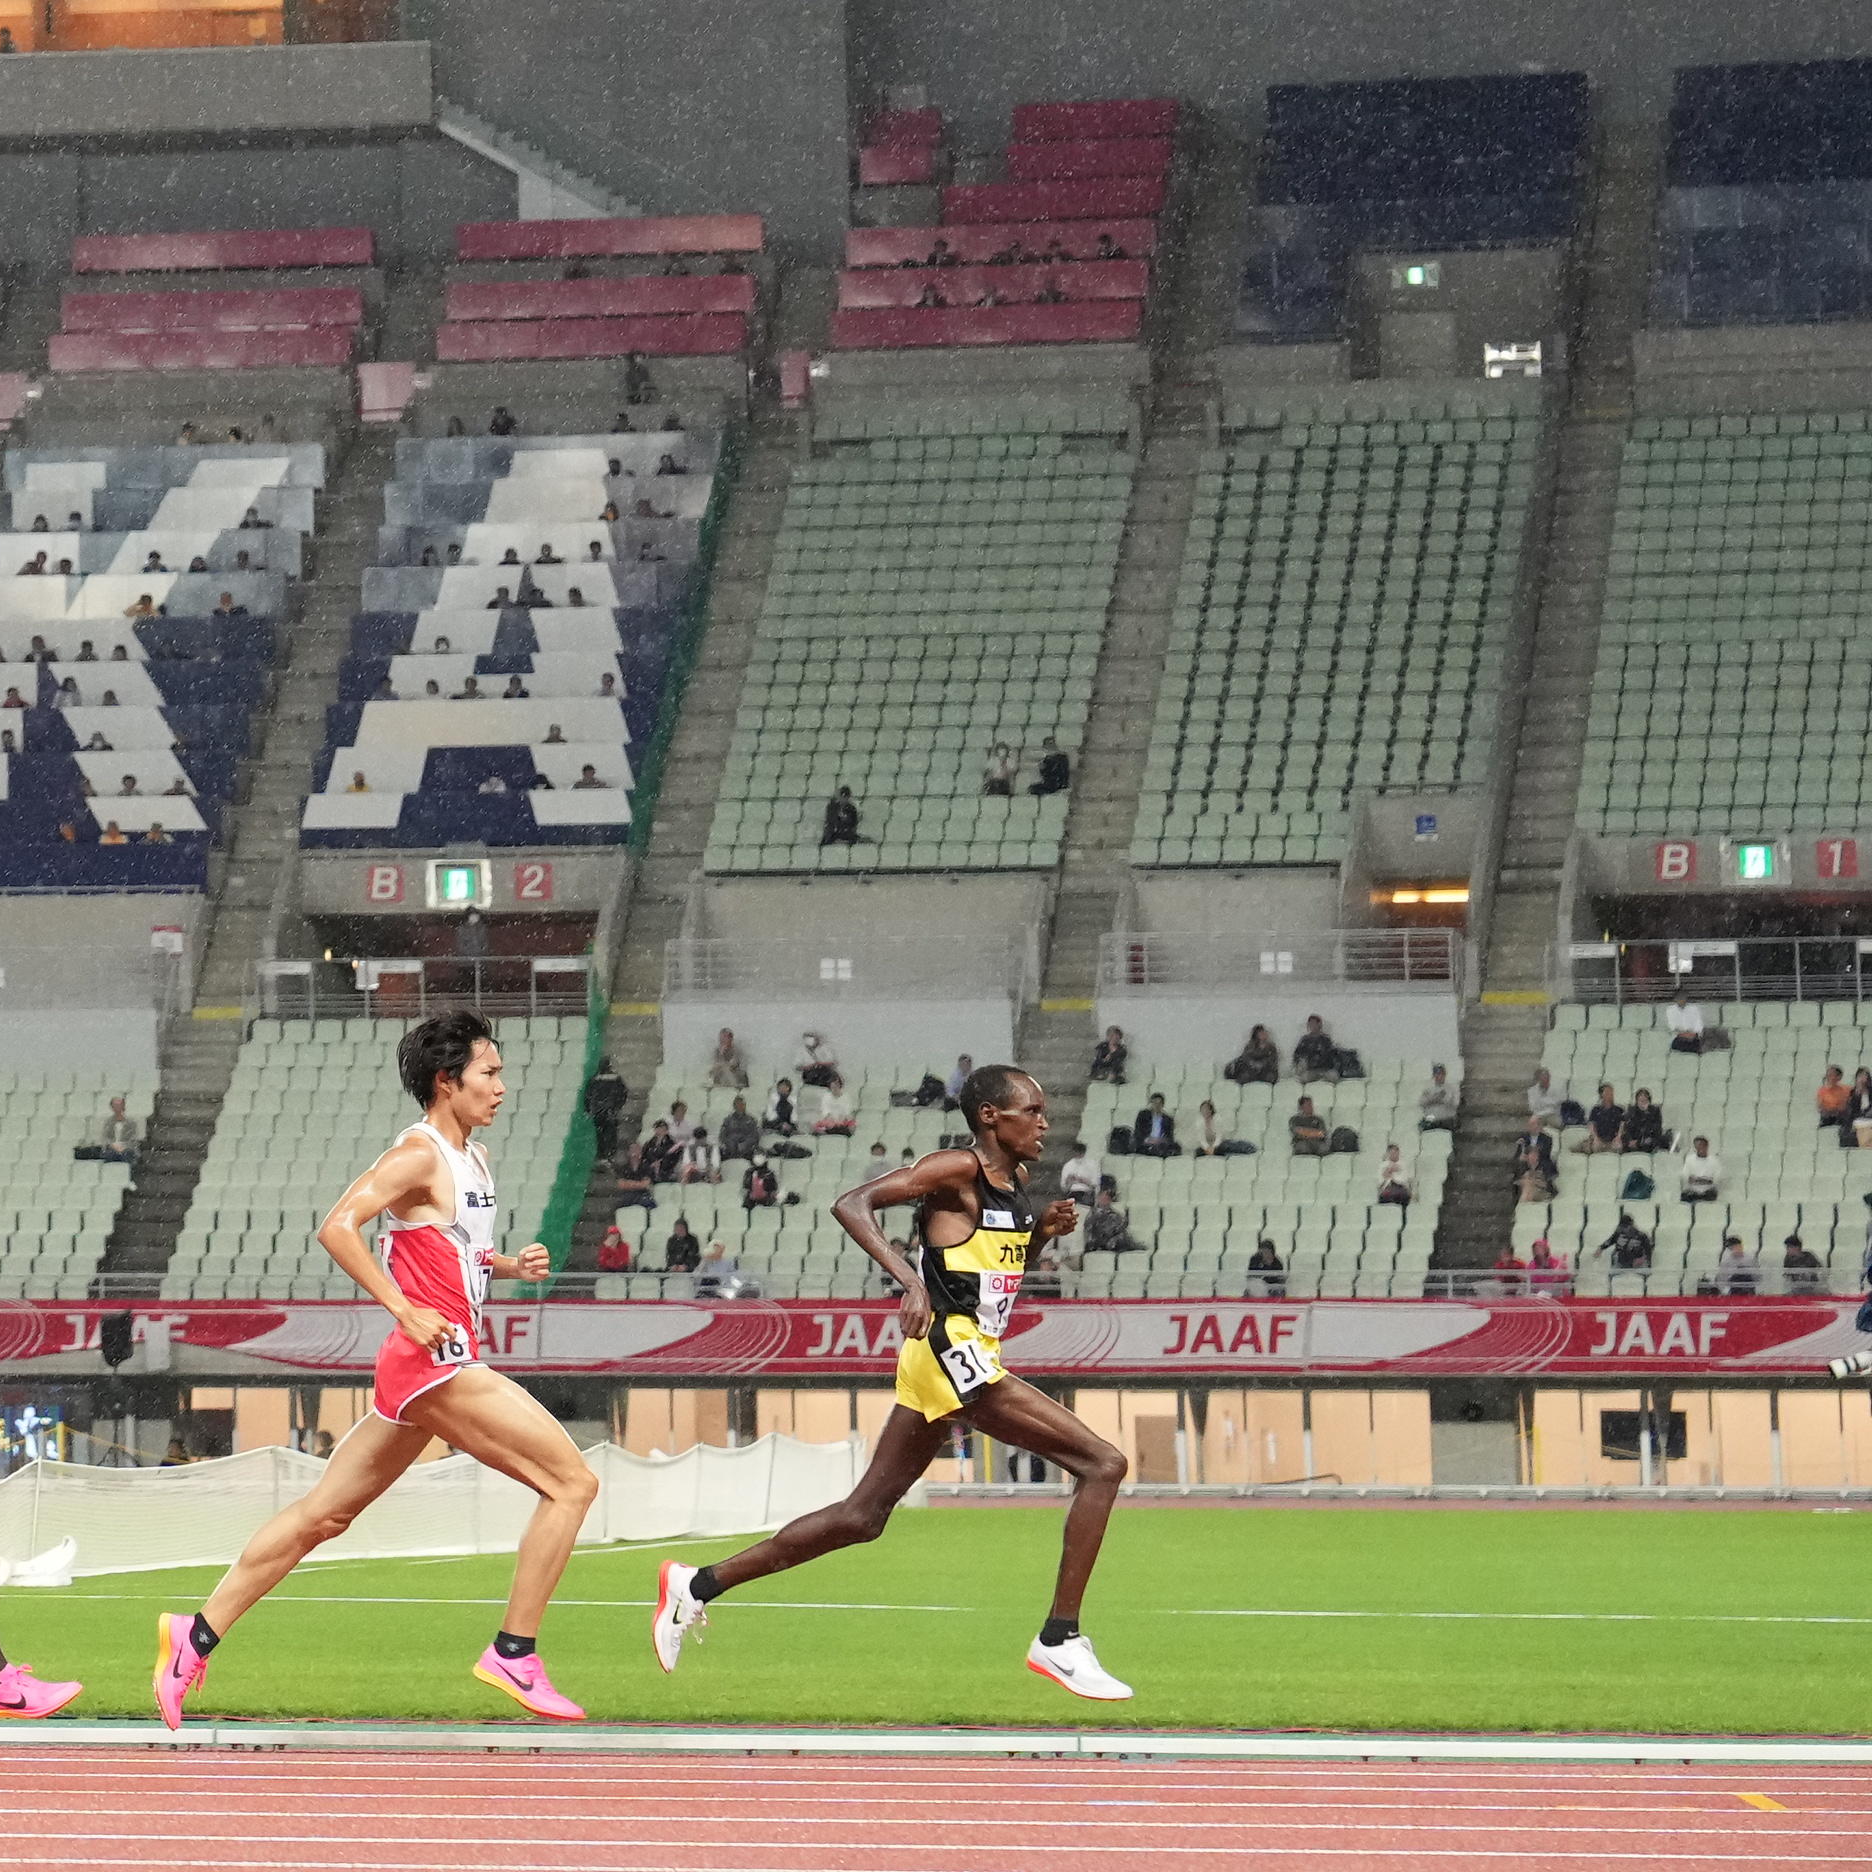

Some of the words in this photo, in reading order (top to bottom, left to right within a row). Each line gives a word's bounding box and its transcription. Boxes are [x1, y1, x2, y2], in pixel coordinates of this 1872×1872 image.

[1661, 844, 1689, 879] B
[1829, 841, 1842, 876] 1
[371, 866, 398, 899] B
[521, 865, 545, 898] 2
[464, 1191, 496, 1208] 富士
[480, 1315, 531, 1354] AF
[807, 1314, 905, 1356] JAA
[1163, 1314, 1297, 1354] JAAF
[1591, 1312, 1729, 1356] JAAF
[950, 1344, 987, 1384] 31
